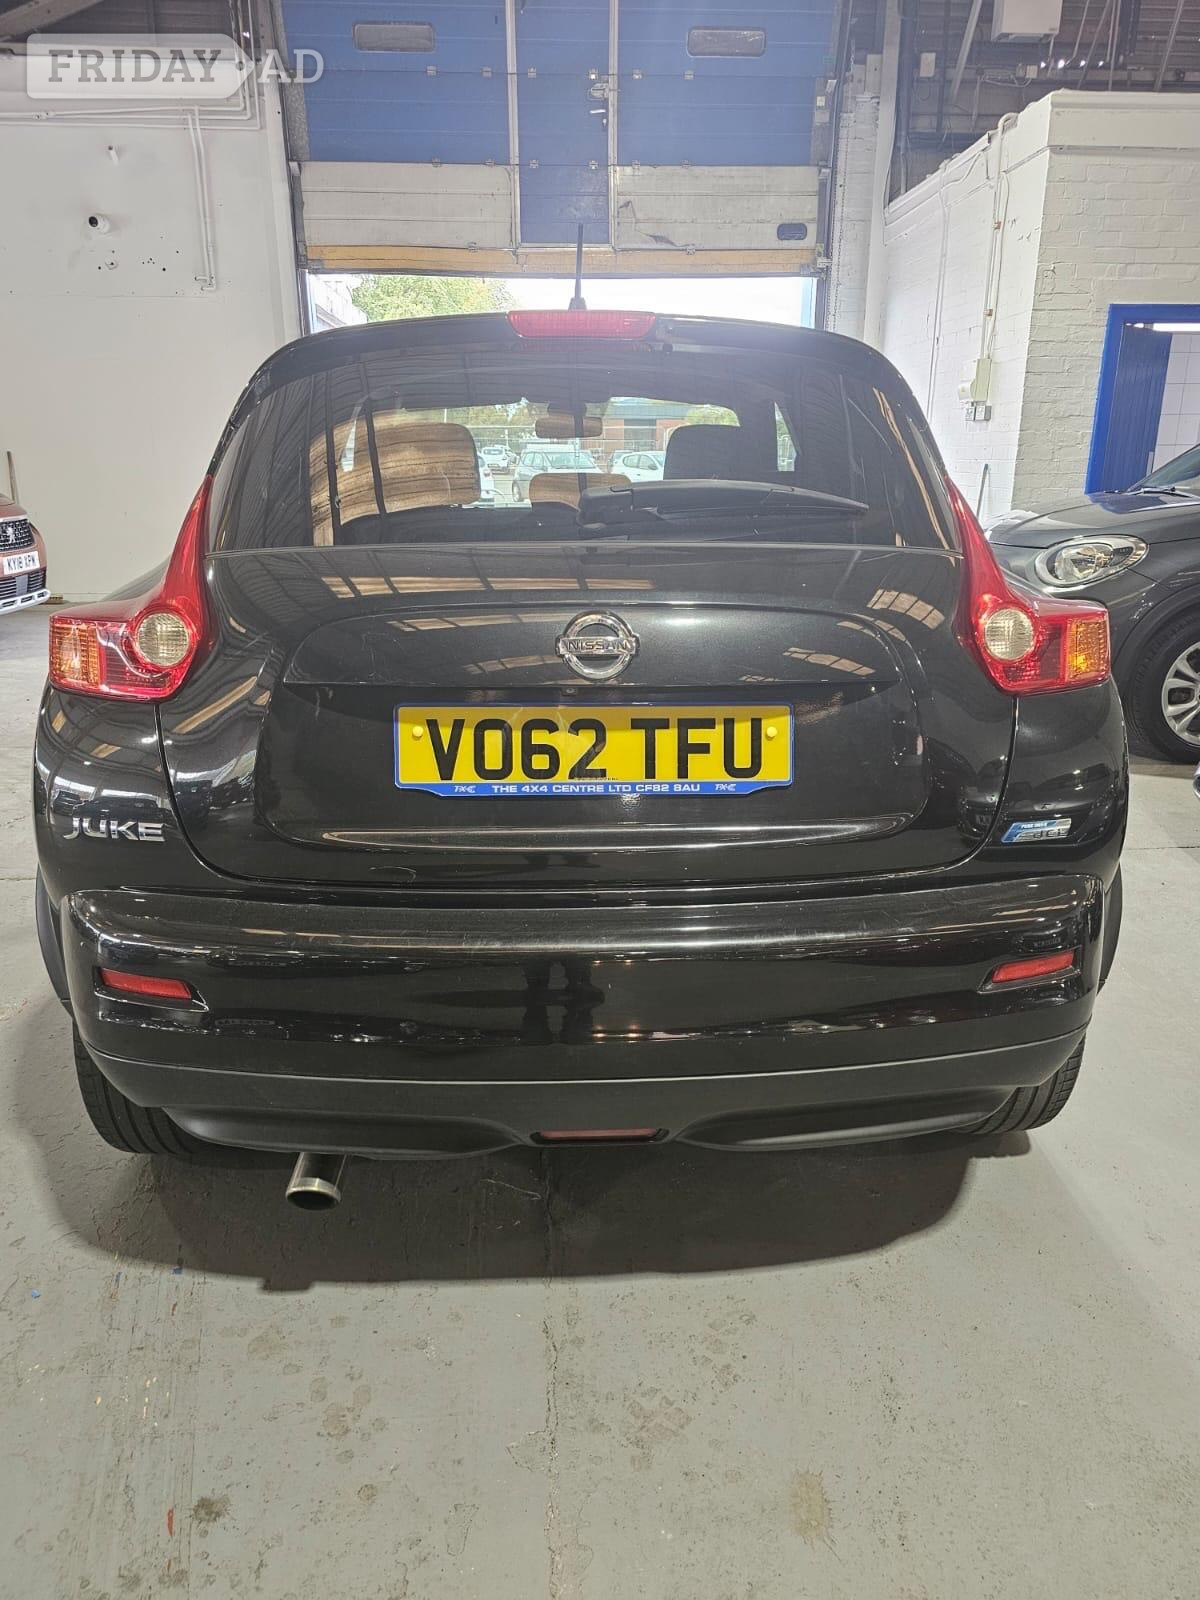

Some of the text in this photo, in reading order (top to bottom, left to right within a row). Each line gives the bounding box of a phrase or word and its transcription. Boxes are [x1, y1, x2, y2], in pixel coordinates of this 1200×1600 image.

[566, 639, 631, 650] NISSAN
[425, 717, 763, 781] VO62 TFU
[491, 785, 518, 793] THE
[521, 785, 548, 793] 4X4
[552, 784, 605, 793] CENTRE
[608, 784, 632, 792] LTD
[63, 817, 165, 842] JUKE
